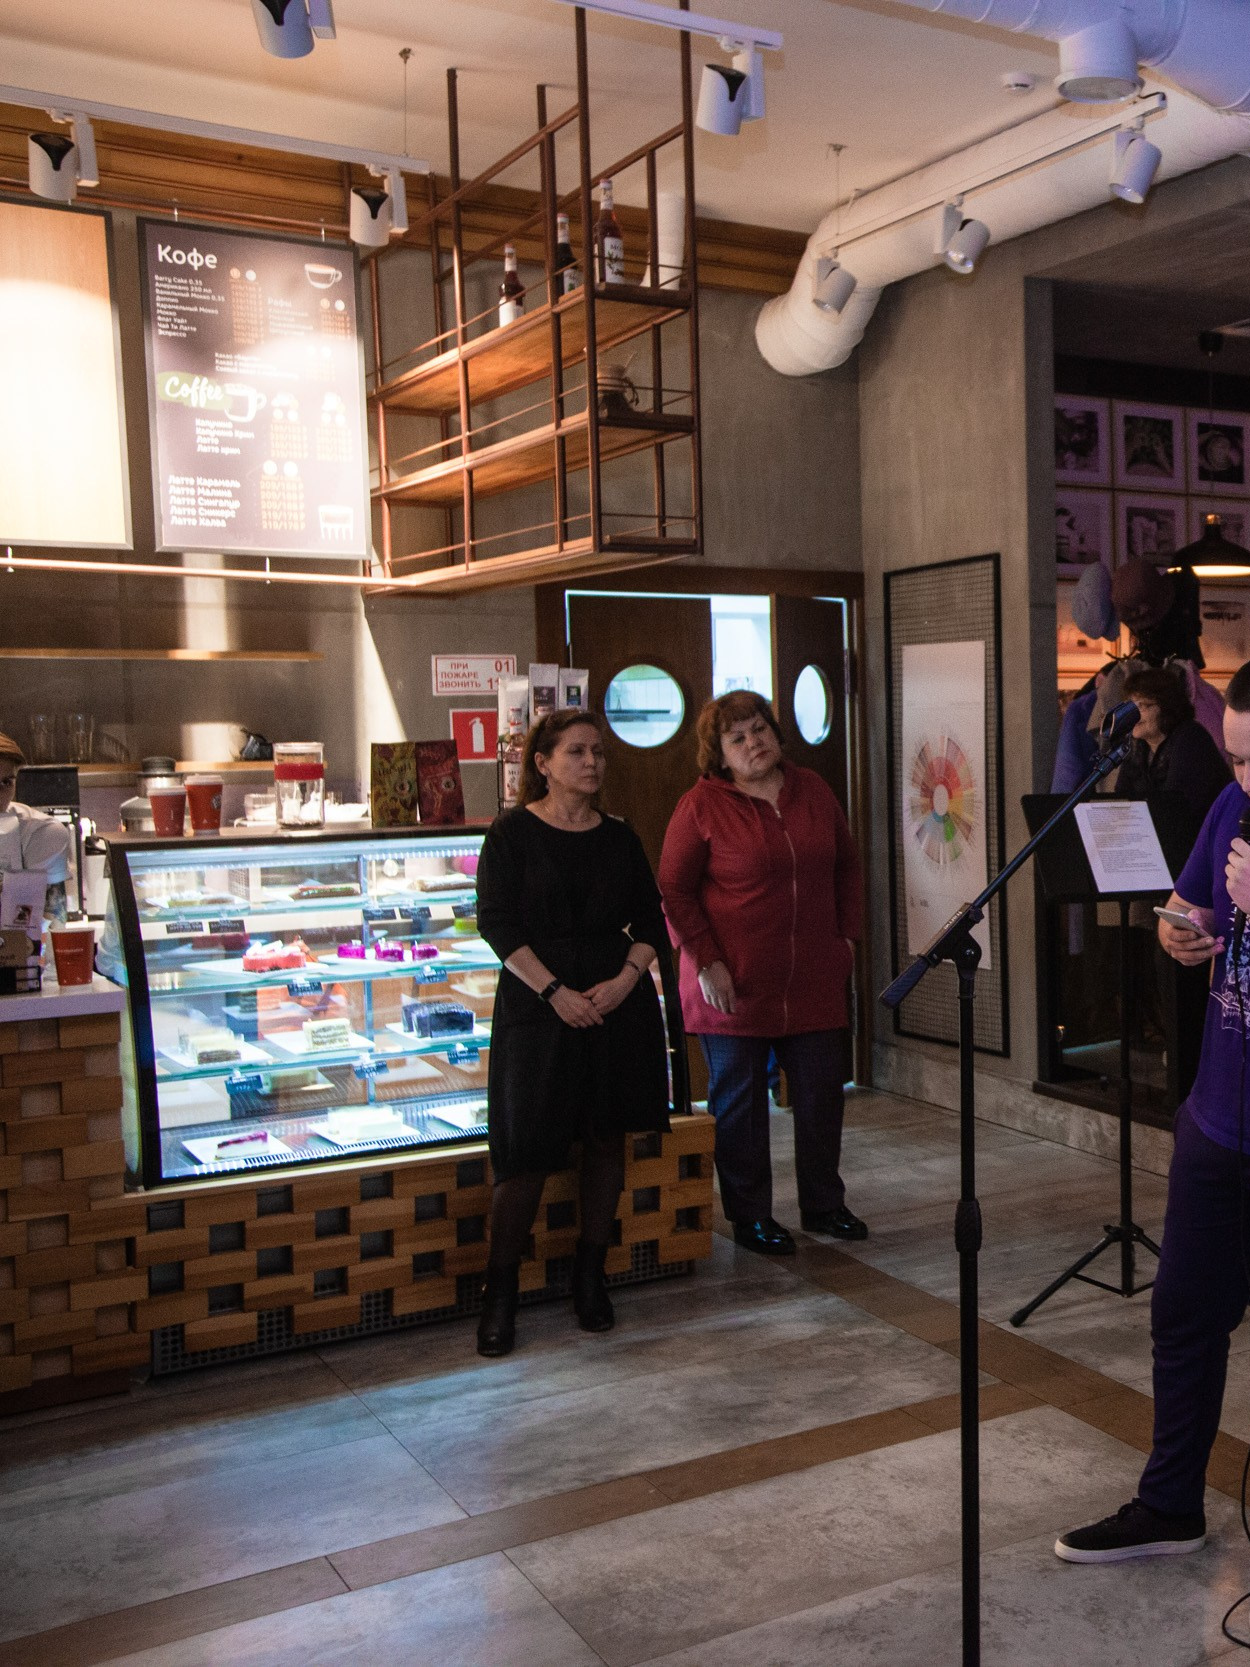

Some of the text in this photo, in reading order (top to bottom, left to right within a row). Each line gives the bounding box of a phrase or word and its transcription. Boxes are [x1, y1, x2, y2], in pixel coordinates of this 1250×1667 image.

[157, 244, 218, 271] Кофе
[165, 376, 225, 409] Coffee
[168, 475, 195, 485] Латте
[169, 485, 195, 495] Латте
[169, 496, 196, 505] Латте
[170, 505, 196, 515] Латте
[171, 516, 197, 526] Латте
[450, 662, 469, 670] ПРИ
[494, 660, 510, 673] 01
[440, 671, 479, 679] ПОЖАРЕ
[439, 680, 482, 688] ЗВОНИТЬ
